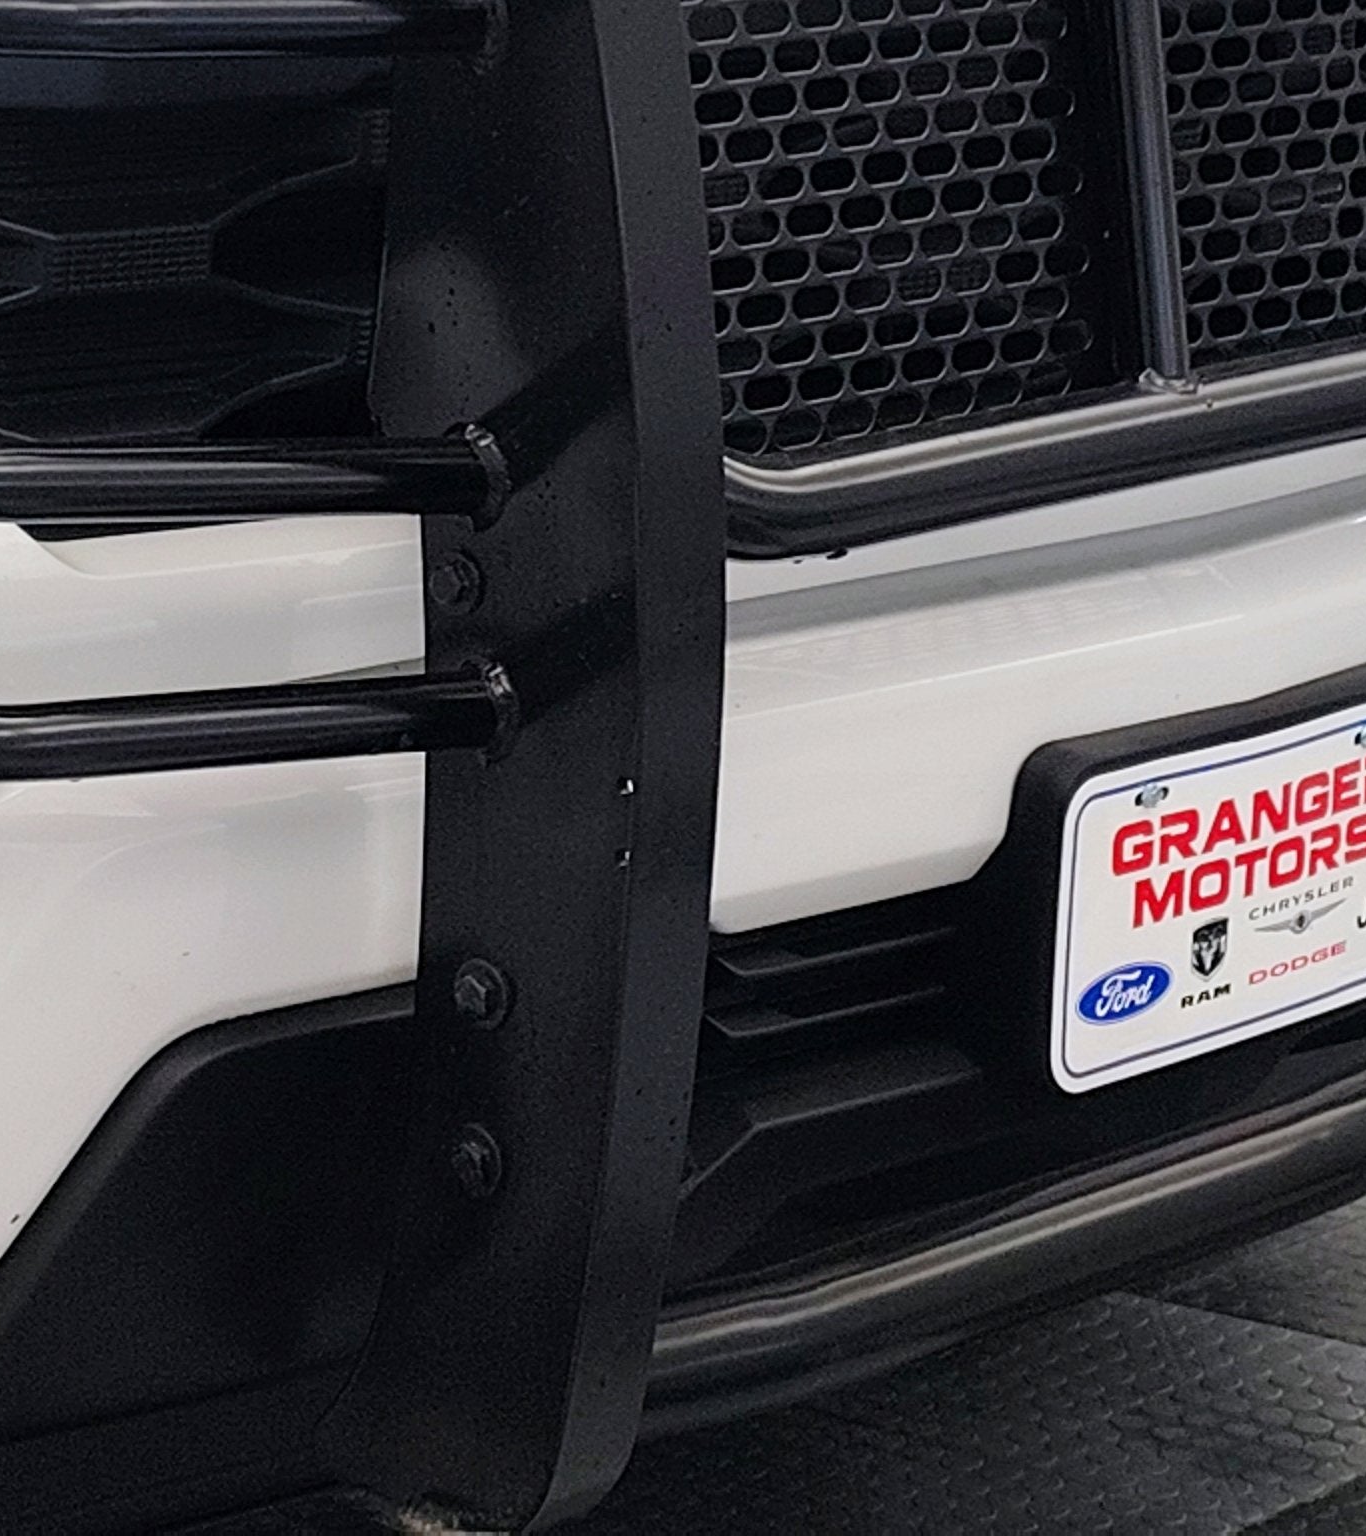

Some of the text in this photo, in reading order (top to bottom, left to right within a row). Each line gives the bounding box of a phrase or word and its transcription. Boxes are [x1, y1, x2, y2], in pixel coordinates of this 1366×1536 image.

[1248, 876, 1355, 921] CHRYSLER
[1248, 940, 1348, 985] DODGE
[1095, 969, 1155, 1018] Ford
[1180, 982, 1232, 1009] RAM
